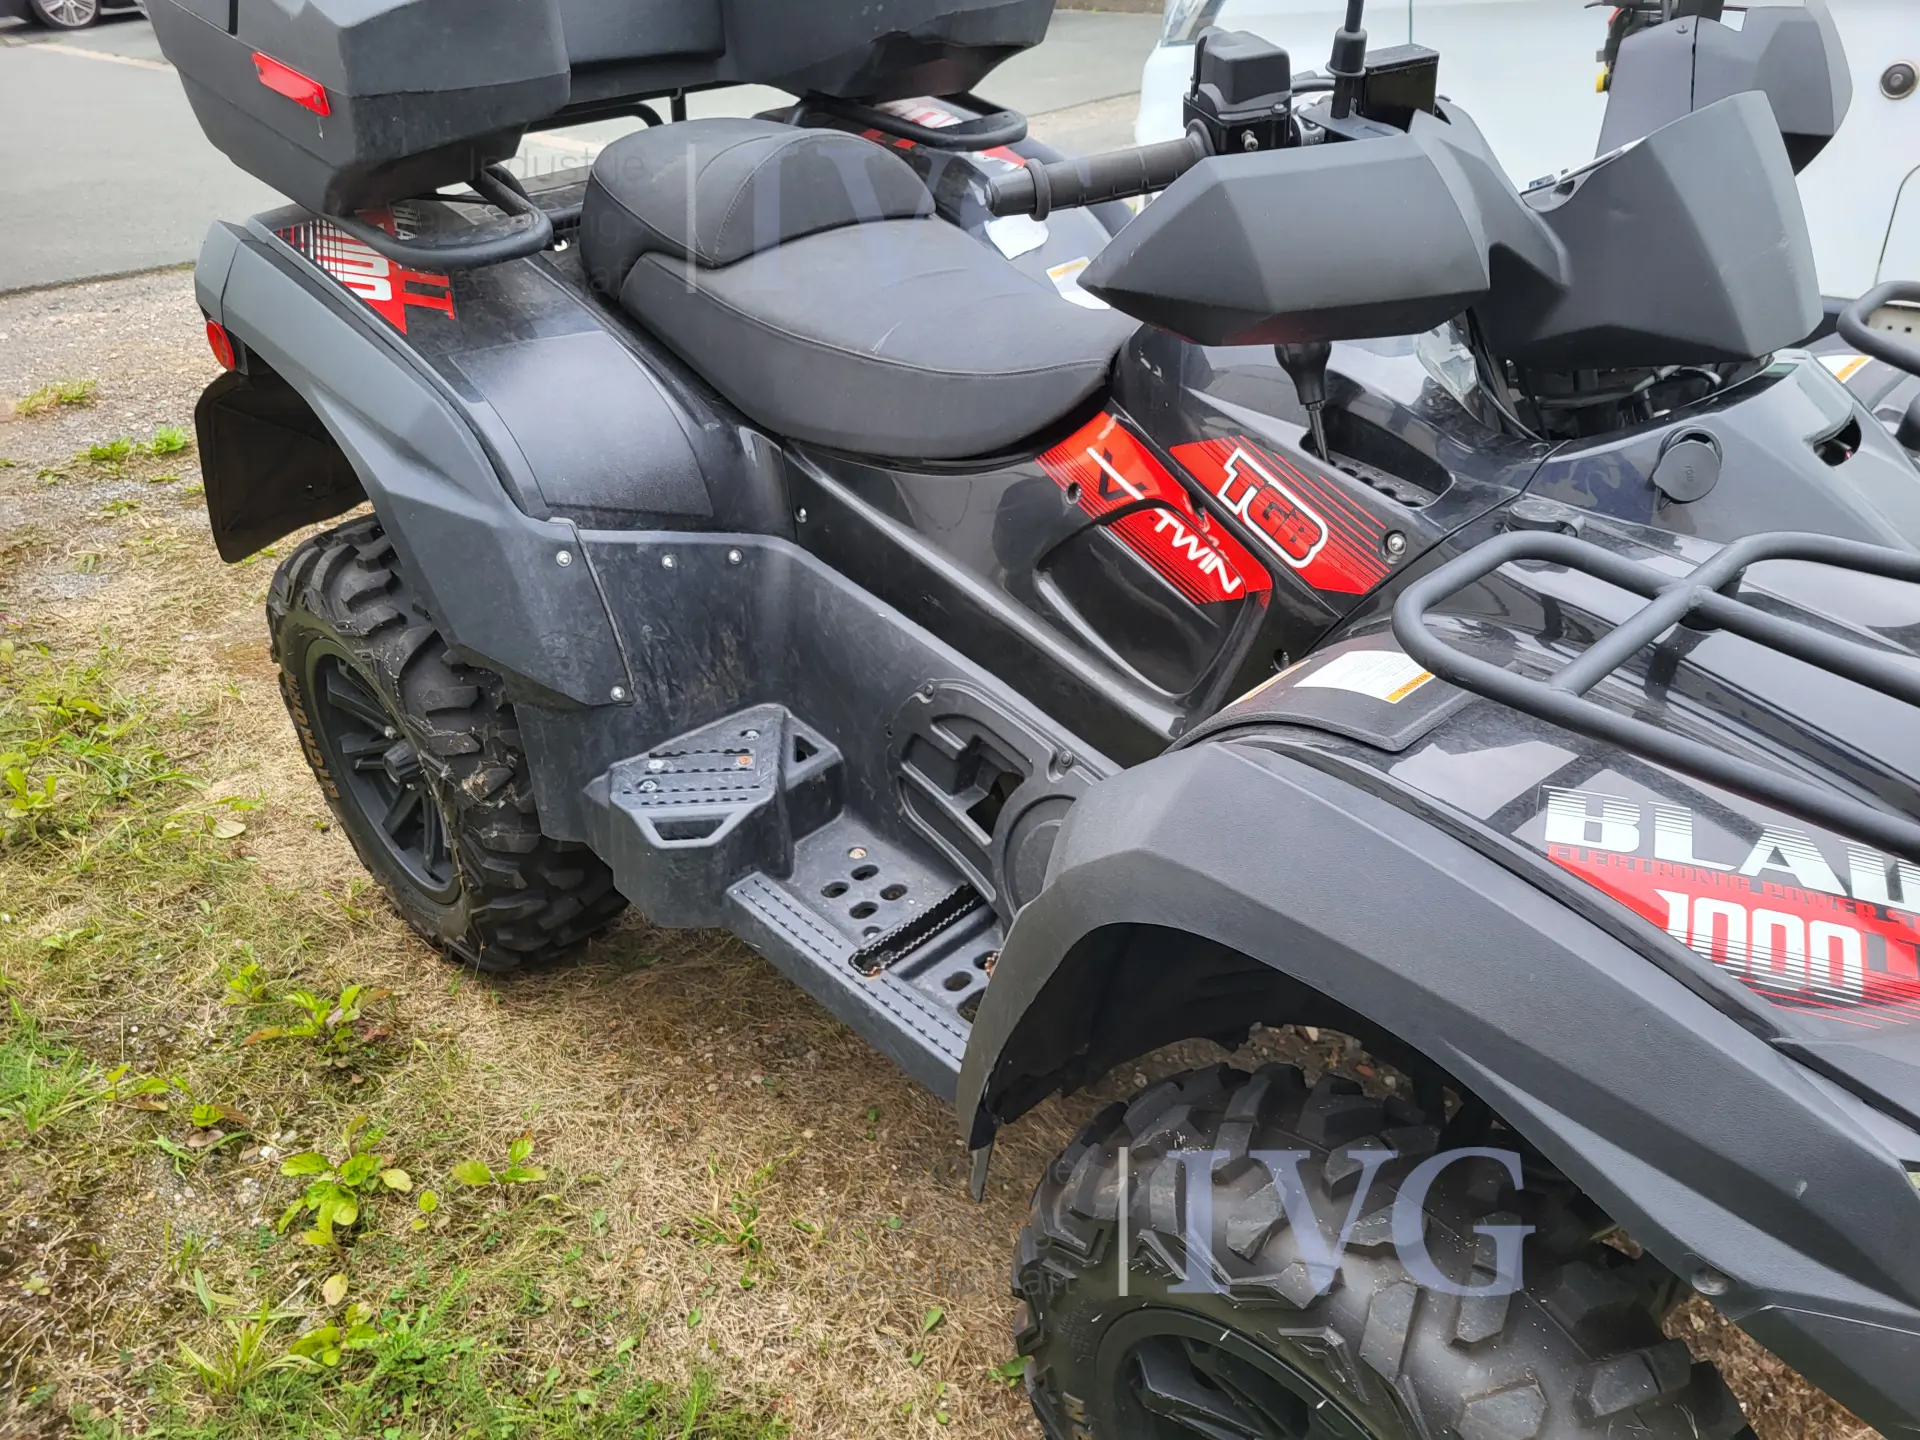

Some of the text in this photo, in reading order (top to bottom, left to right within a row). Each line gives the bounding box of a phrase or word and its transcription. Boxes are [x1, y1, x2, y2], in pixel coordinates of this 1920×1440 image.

[1154, 507, 1243, 593] TWIN
[1217, 447, 1329, 568] TGB
[1547, 844, 1751, 889] ELECTRONIC
[1653, 888, 1863, 1004] 1000
